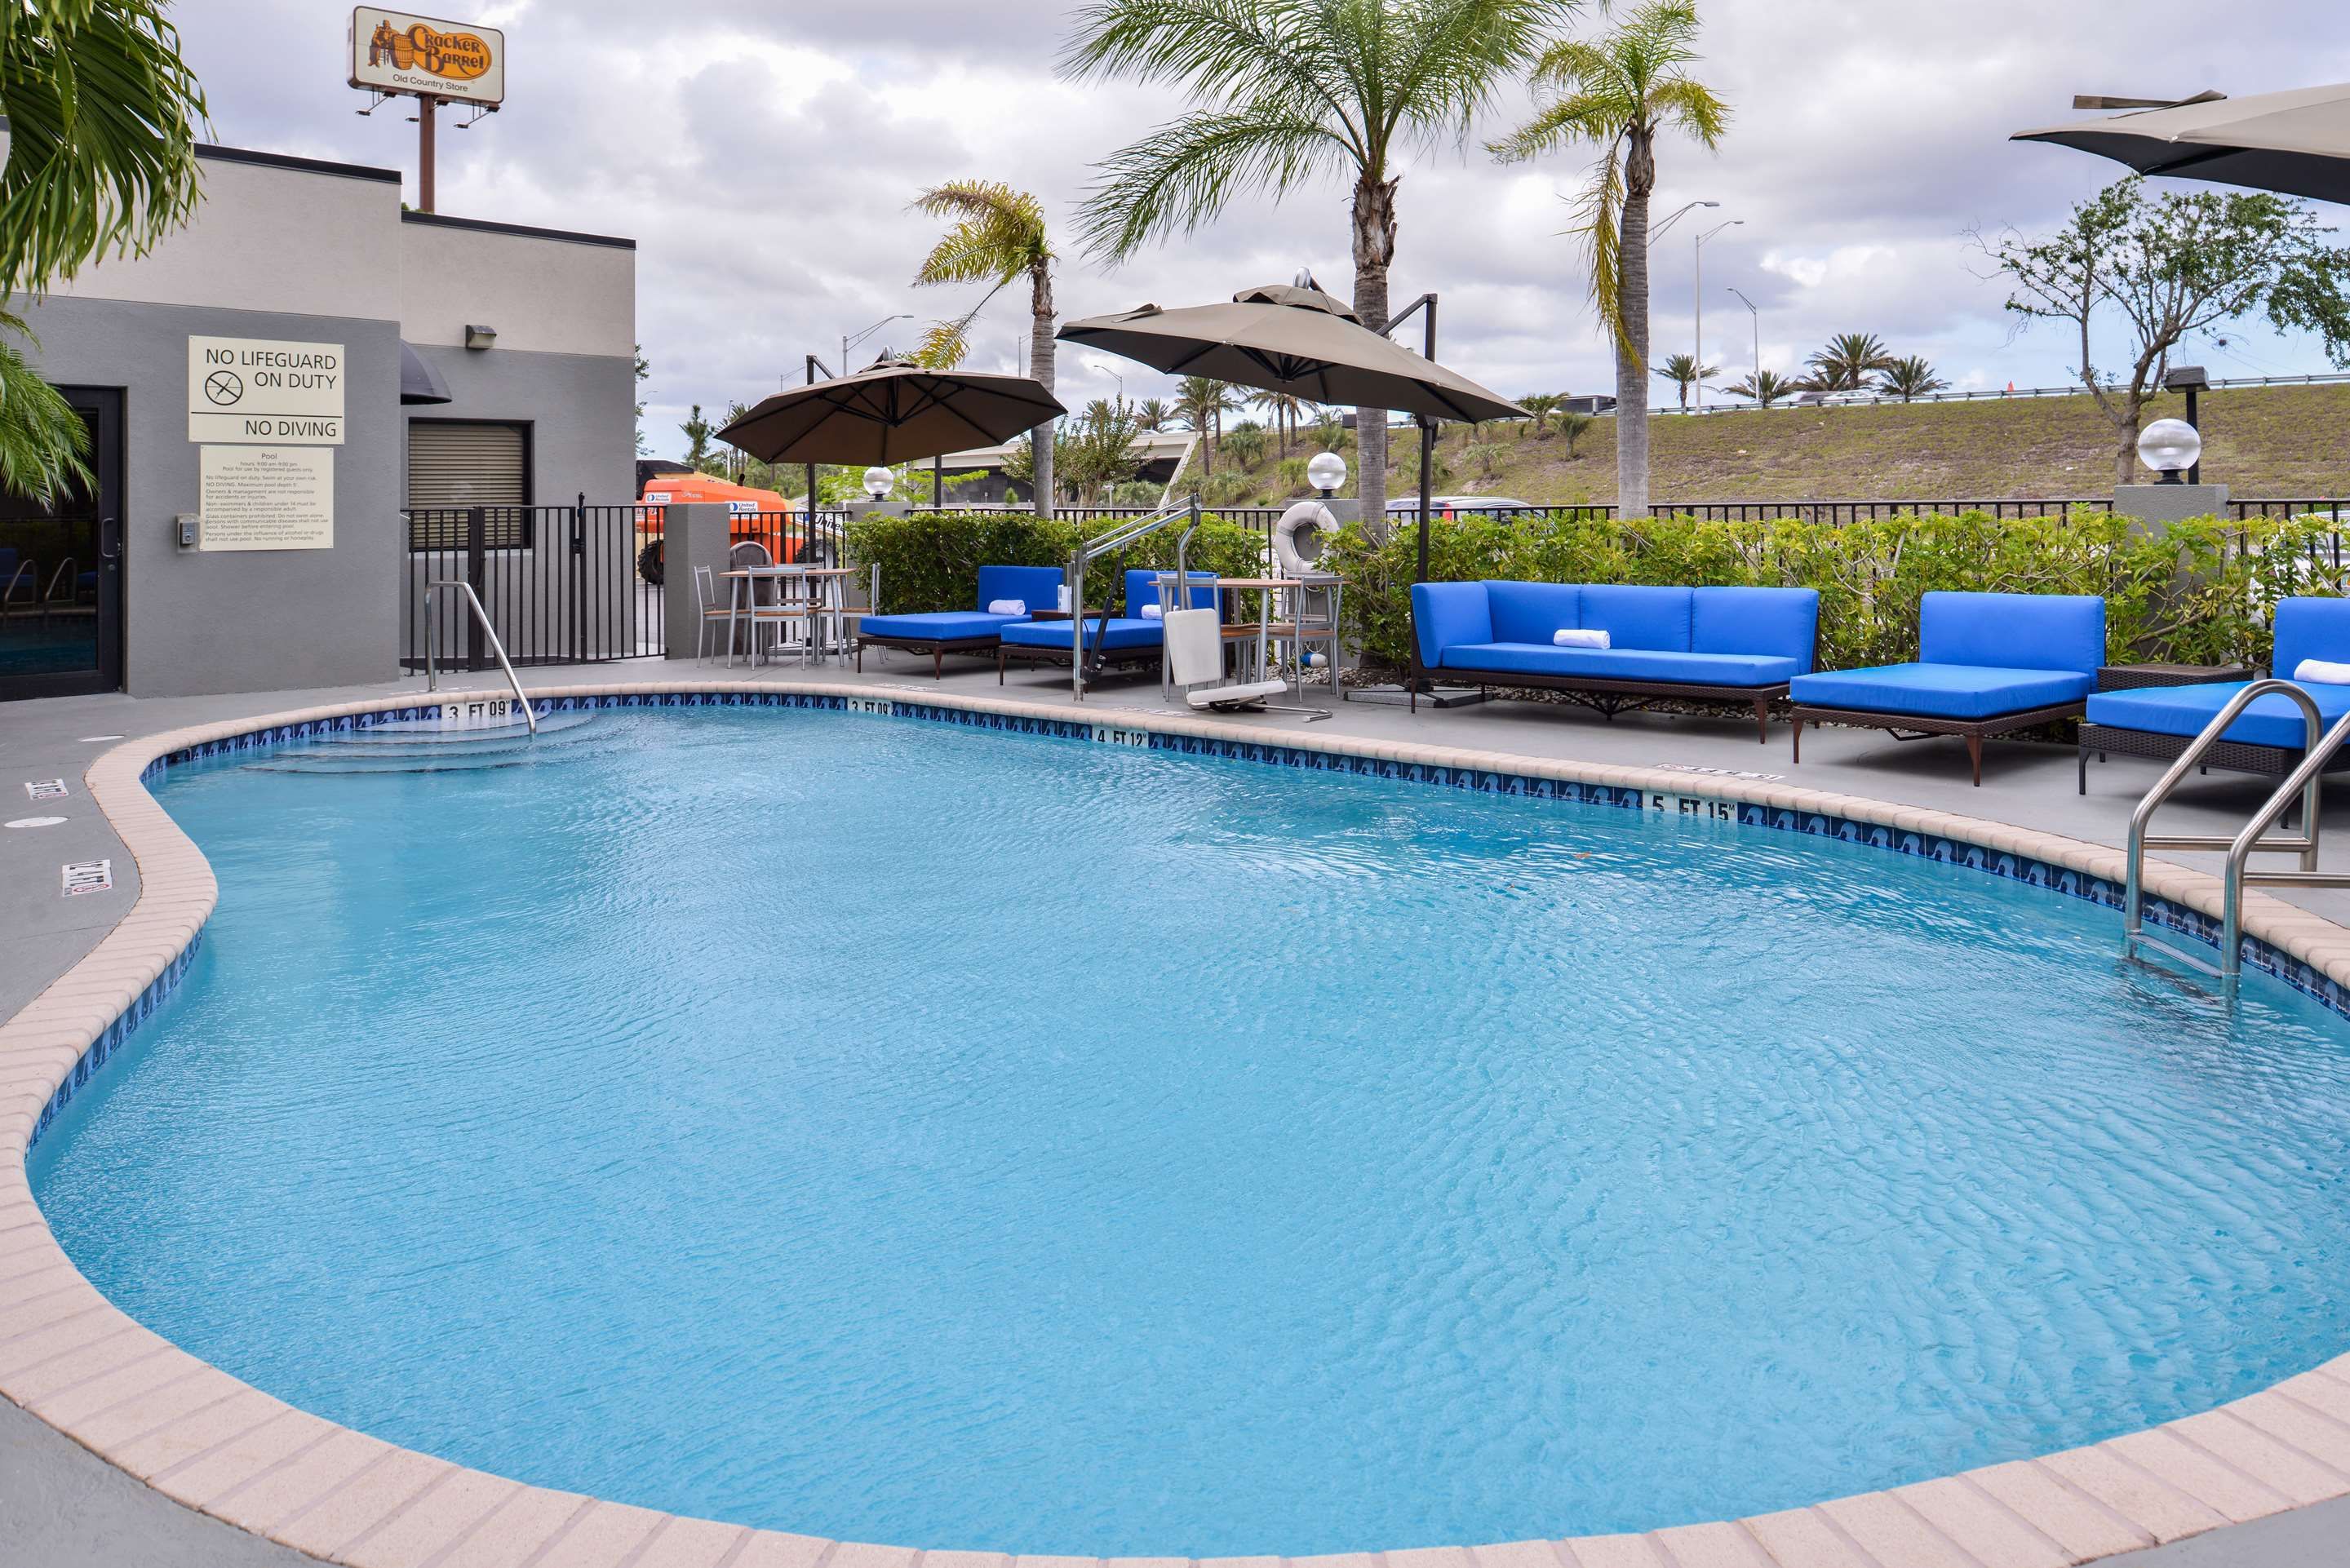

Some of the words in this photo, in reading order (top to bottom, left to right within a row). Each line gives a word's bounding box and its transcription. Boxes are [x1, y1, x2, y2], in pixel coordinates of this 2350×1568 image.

[408, 24, 481, 54] Cracker
[425, 46, 484, 74] Barrel
[392, 73, 408, 83] Old
[410, 77, 443, 90] Country
[446, 80, 468, 92] Store
[206, 348, 235, 365] NO
[241, 350, 337, 370] LIFEGUARD
[254, 371, 282, 388] ON
[288, 373, 337, 390] DUTY
[245, 420, 272, 436] NO
[277, 421, 337, 437] DIVING
[449, 706, 459, 718] 3
[469, 703, 485, 718] FT
[1097, 729, 1106, 742] 4
[1113, 730, 1127, 745] FT
[1652, 795, 1665, 813] 5
[1678, 798, 1700, 817] FT
